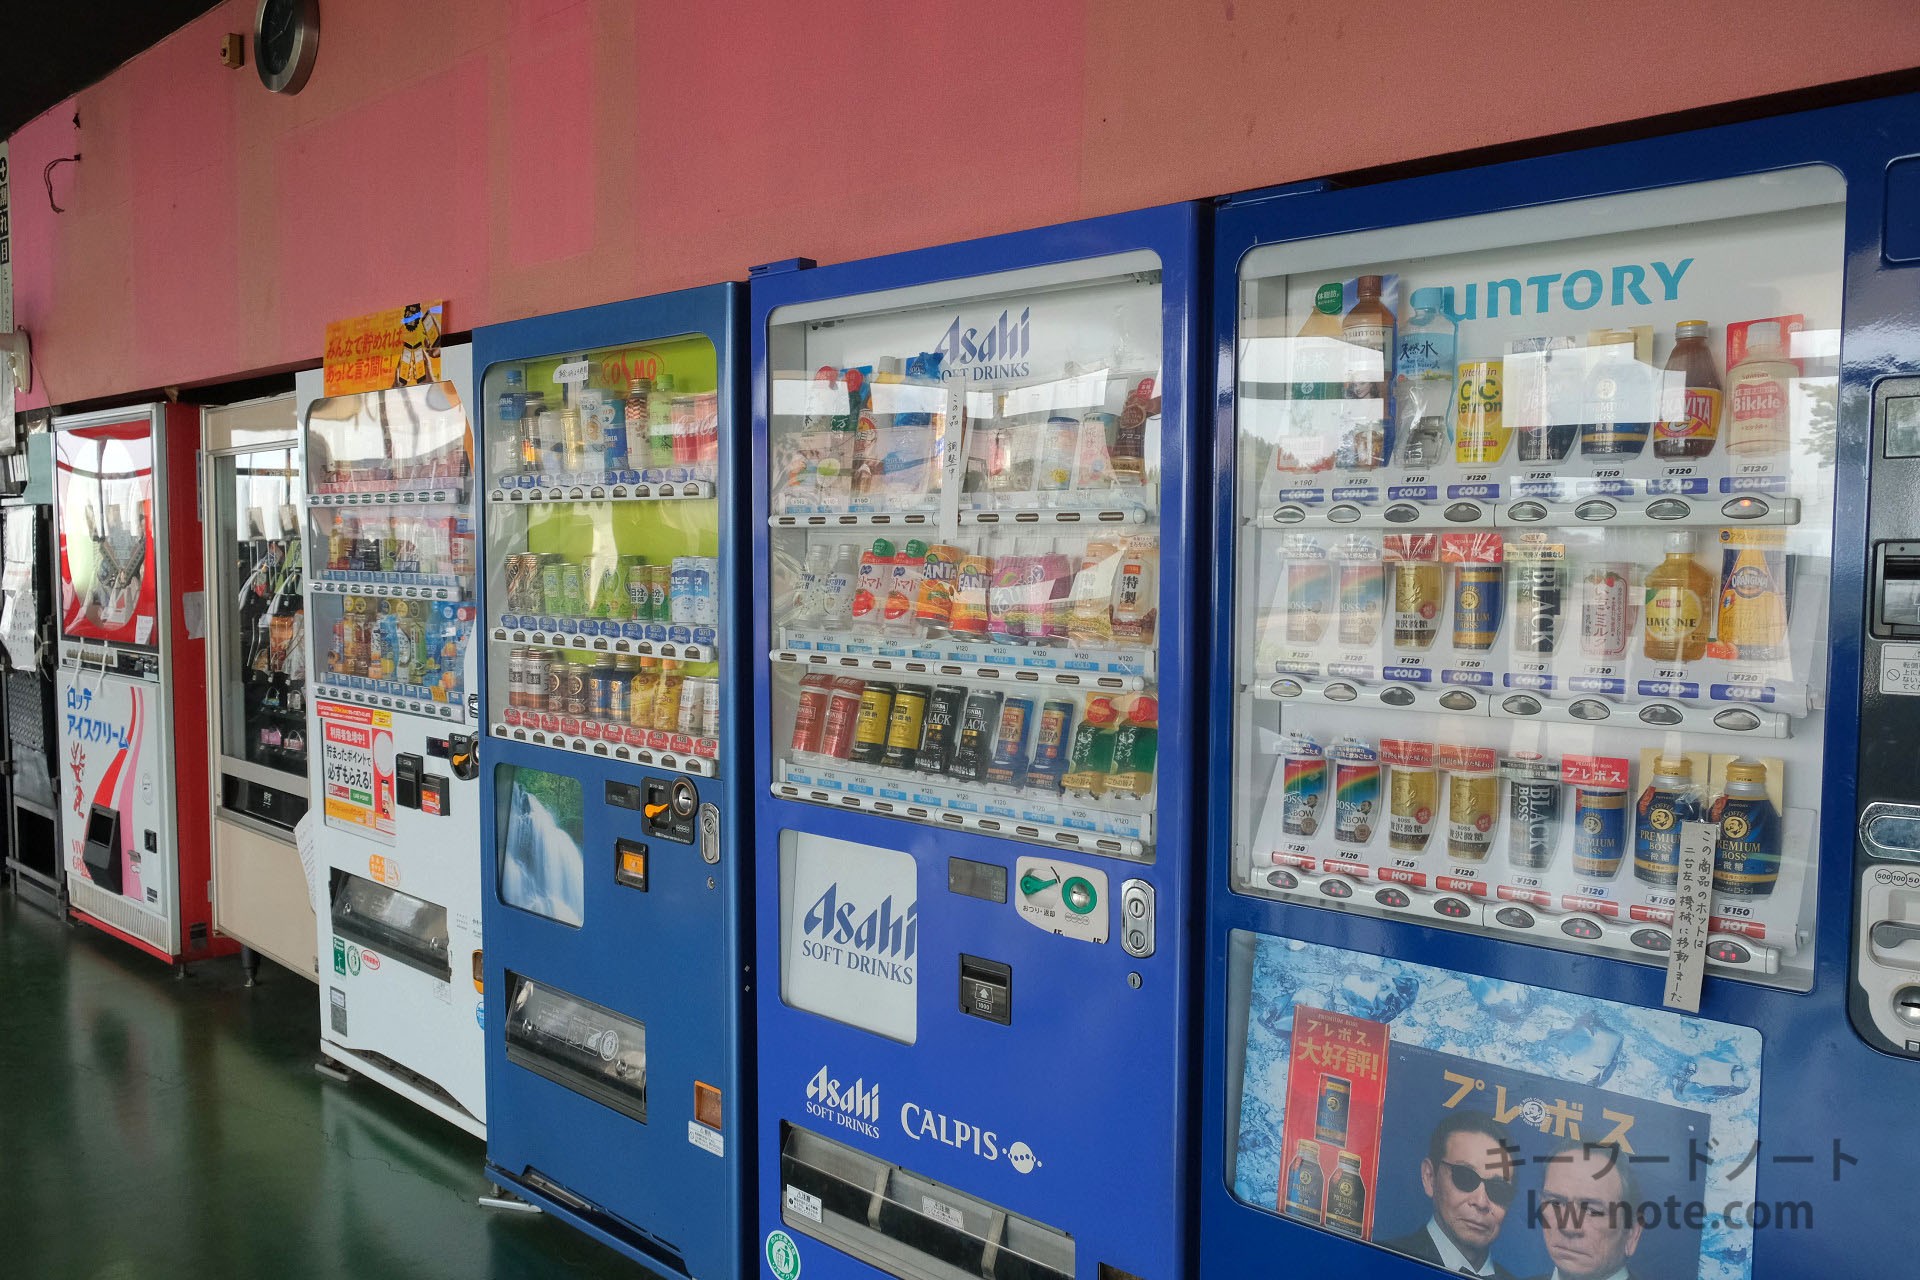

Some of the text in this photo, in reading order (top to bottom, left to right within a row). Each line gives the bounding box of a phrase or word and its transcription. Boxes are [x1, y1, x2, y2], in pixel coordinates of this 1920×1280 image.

[935, 306, 1029, 365] Asahi
[1400, 340, 1439, 360] 天然水
[973, 361, 1029, 380] DRINKS
[1733, 394, 1781, 413] Bikkle
[1595, 470, 1620, 478] ¥150
[1667, 467, 1693, 476] ¥120
[1742, 464, 1769, 473] ¥120
[1349, 477, 1369, 486] ¥150
[1405, 475, 1425, 483] ¥110
[1466, 474, 1488, 482] ¥120
[1530, 472, 1552, 480] ¥120
[1659, 480, 1694, 491] COLD
[1734, 478, 1772, 489] COLD
[1289, 490, 1314, 499] COLD
[1341, 488, 1367, 498] COLD
[1399, 487, 1426, 497] COLD
[1458, 486, 1488, 496] COLD
[923, 563, 957, 581] FANTA
[860, 577, 883, 590] トマト
[893, 578, 917, 592] トマト
[1125, 575, 1139, 605] 特製
[1532, 567, 1557, 650] BLACK
[1460, 660, 1481, 668] ¥120
[1523, 663, 1545, 671] ¥120
[1394, 668, 1421, 679] COLD
[1590, 666, 1612, 674] ¥120
[1659, 670, 1684, 679] ¥120
[1452, 671, 1482, 683] COLD
[1515, 675, 1546, 686] COLD
[1731, 673, 1758, 682] ¥120
[1582, 680, 1614, 691] COLD
[1651, 683, 1687, 695] COLD
[1725, 687, 1761, 699] COLD
[928, 713, 951, 726] LACK
[67, 714, 130, 750] アイスクリーム
[326, 744, 371, 767] 貯まったポイントで
[327, 762, 372, 790] 必ずもらえる!
[1567, 766, 1625, 784] プレボス。
[1518, 786, 1529, 822] BOSS
[1287, 844, 1306, 852] ¥120
[1649, 842, 1674, 852] BOSS
[1340, 851, 1359, 860] ¥120
[1650, 852, 1670, 862] 微糖
[1721, 851, 1747, 861] BOSS
[1335, 863, 1356, 873] HOT
[1396, 858, 1416, 868] ¥120
[1722, 861, 1744, 872] 微糖
[1391, 871, 1414, 882] HOT
[1455, 867, 1475, 877] ¥120
[1877, 873, 1892, 881] 500
[1893, 874, 1906, 882] 100
[1450, 880, 1474, 891] HOT
[1516, 877, 1538, 886] ¥120
[1511, 888, 1537, 900] HOT
[1582, 886, 1604, 895] ¥120
[1694, 830, 1712, 949] この商品のホットは
[1576, 898, 1601, 911] HOT
[1650, 895, 1676, 905] ¥150
[1022, 905, 1056, 918] おつり・返却
[1646, 908, 1674, 922] HOT
[1723, 905, 1750, 916] ¥150
[804, 882, 917, 961] Asahi
[1671, 847, 1695, 1003] 二台左の機械に移動しました
[1719, 919, 1749, 932] HOT
[802, 940, 913, 985] SOFT DRINKS
[1306, 1019, 1371, 1047] プレボス。
[1298, 1036, 1379, 1081] 大好評!
[806, 1065, 879, 1123] Asahi
[1442, 1069, 1636, 1155] プレボス
[806, 1101, 880, 1139] SOFT DRINKS
[900, 1102, 998, 1161] CALPIS
